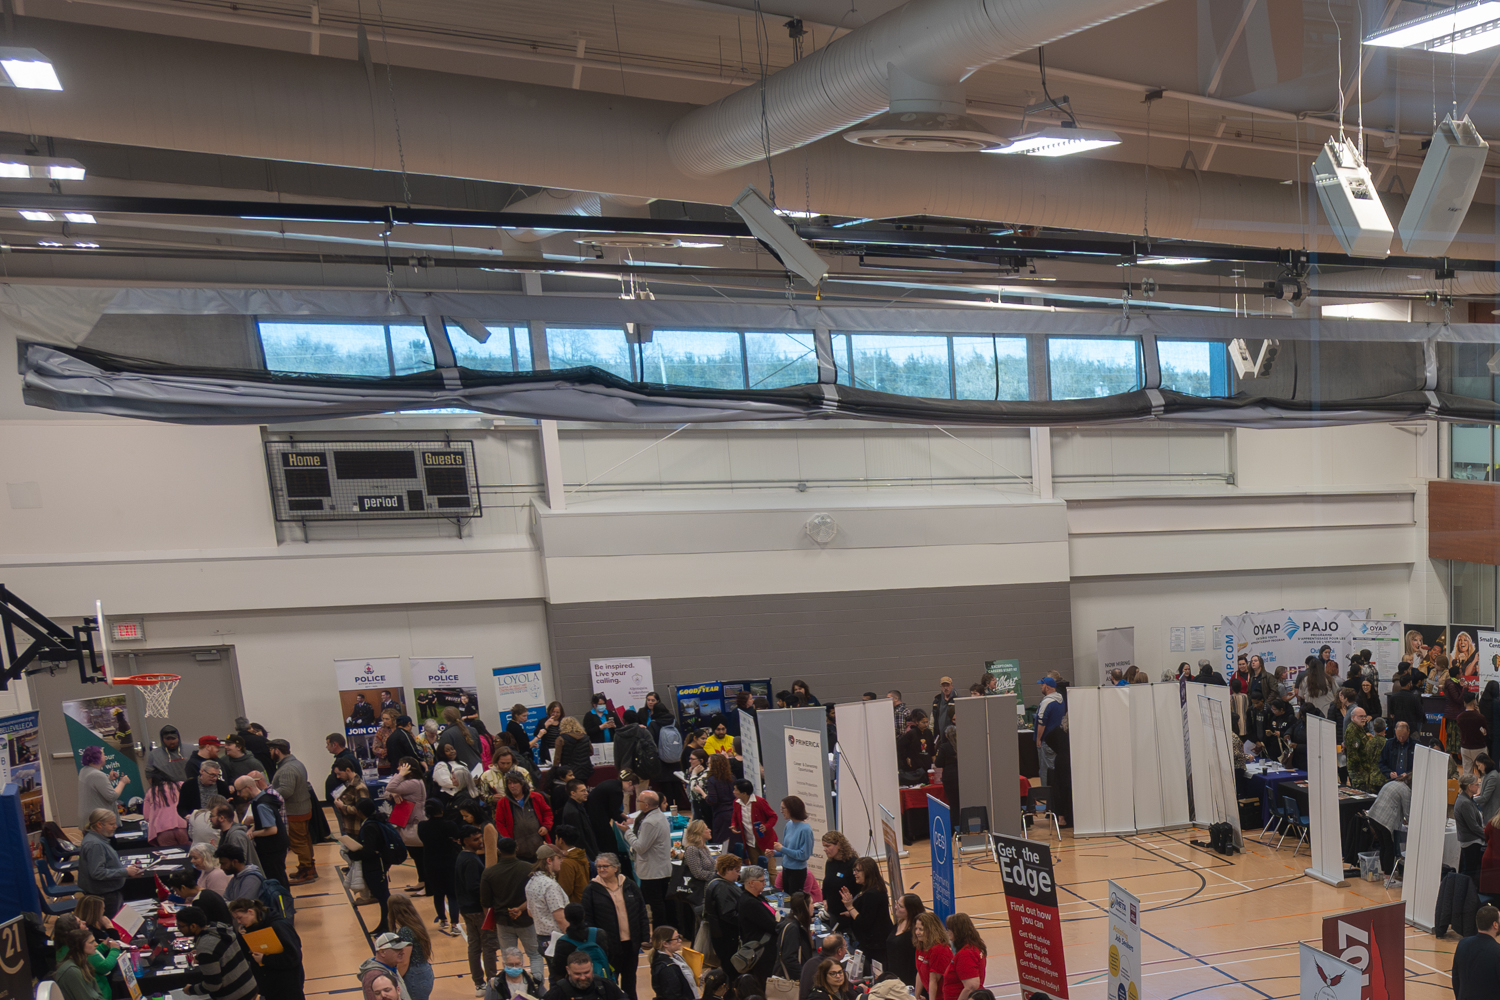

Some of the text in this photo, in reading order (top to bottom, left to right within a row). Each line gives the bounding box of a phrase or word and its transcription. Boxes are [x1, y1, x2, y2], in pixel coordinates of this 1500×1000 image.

[289, 454, 320, 466] Home
[425, 452, 462, 466] Guests
[364, 496, 398, 510] period
[118, 624, 137, 636] EXIT
[1253, 623, 1280, 636] OYAP
[1303, 621, 1339, 632] PAJO
[605, 663, 635, 671] inspired.
[355, 675, 386, 683] POLICE
[498, 673, 540, 686] LOYOLA
[612, 670, 627, 678] your
[596, 677, 621, 685] calling.
[996, 675, 1018, 689] ilbert
[679, 685, 719, 696] GOODYEAR
[348, 727, 365, 735] JOIN
[796, 739, 819, 748] PRIMERICA
[105, 761, 120, 769] with
[998, 843, 1040, 864] Get the
[1001, 857, 1051, 897] Edge
[1010, 902, 1052, 921] Find out how
[1021, 915, 1044, 929] you can
[2, 923, 22, 958] 21
[1019, 930, 1051, 946] Get the advice
[1024, 941, 1049, 955] Get the job
[1024, 950, 1052, 966] Get the skills
[1020, 959, 1059, 978] Get the employee
[1022, 972, 1060, 992] Contact us today!
